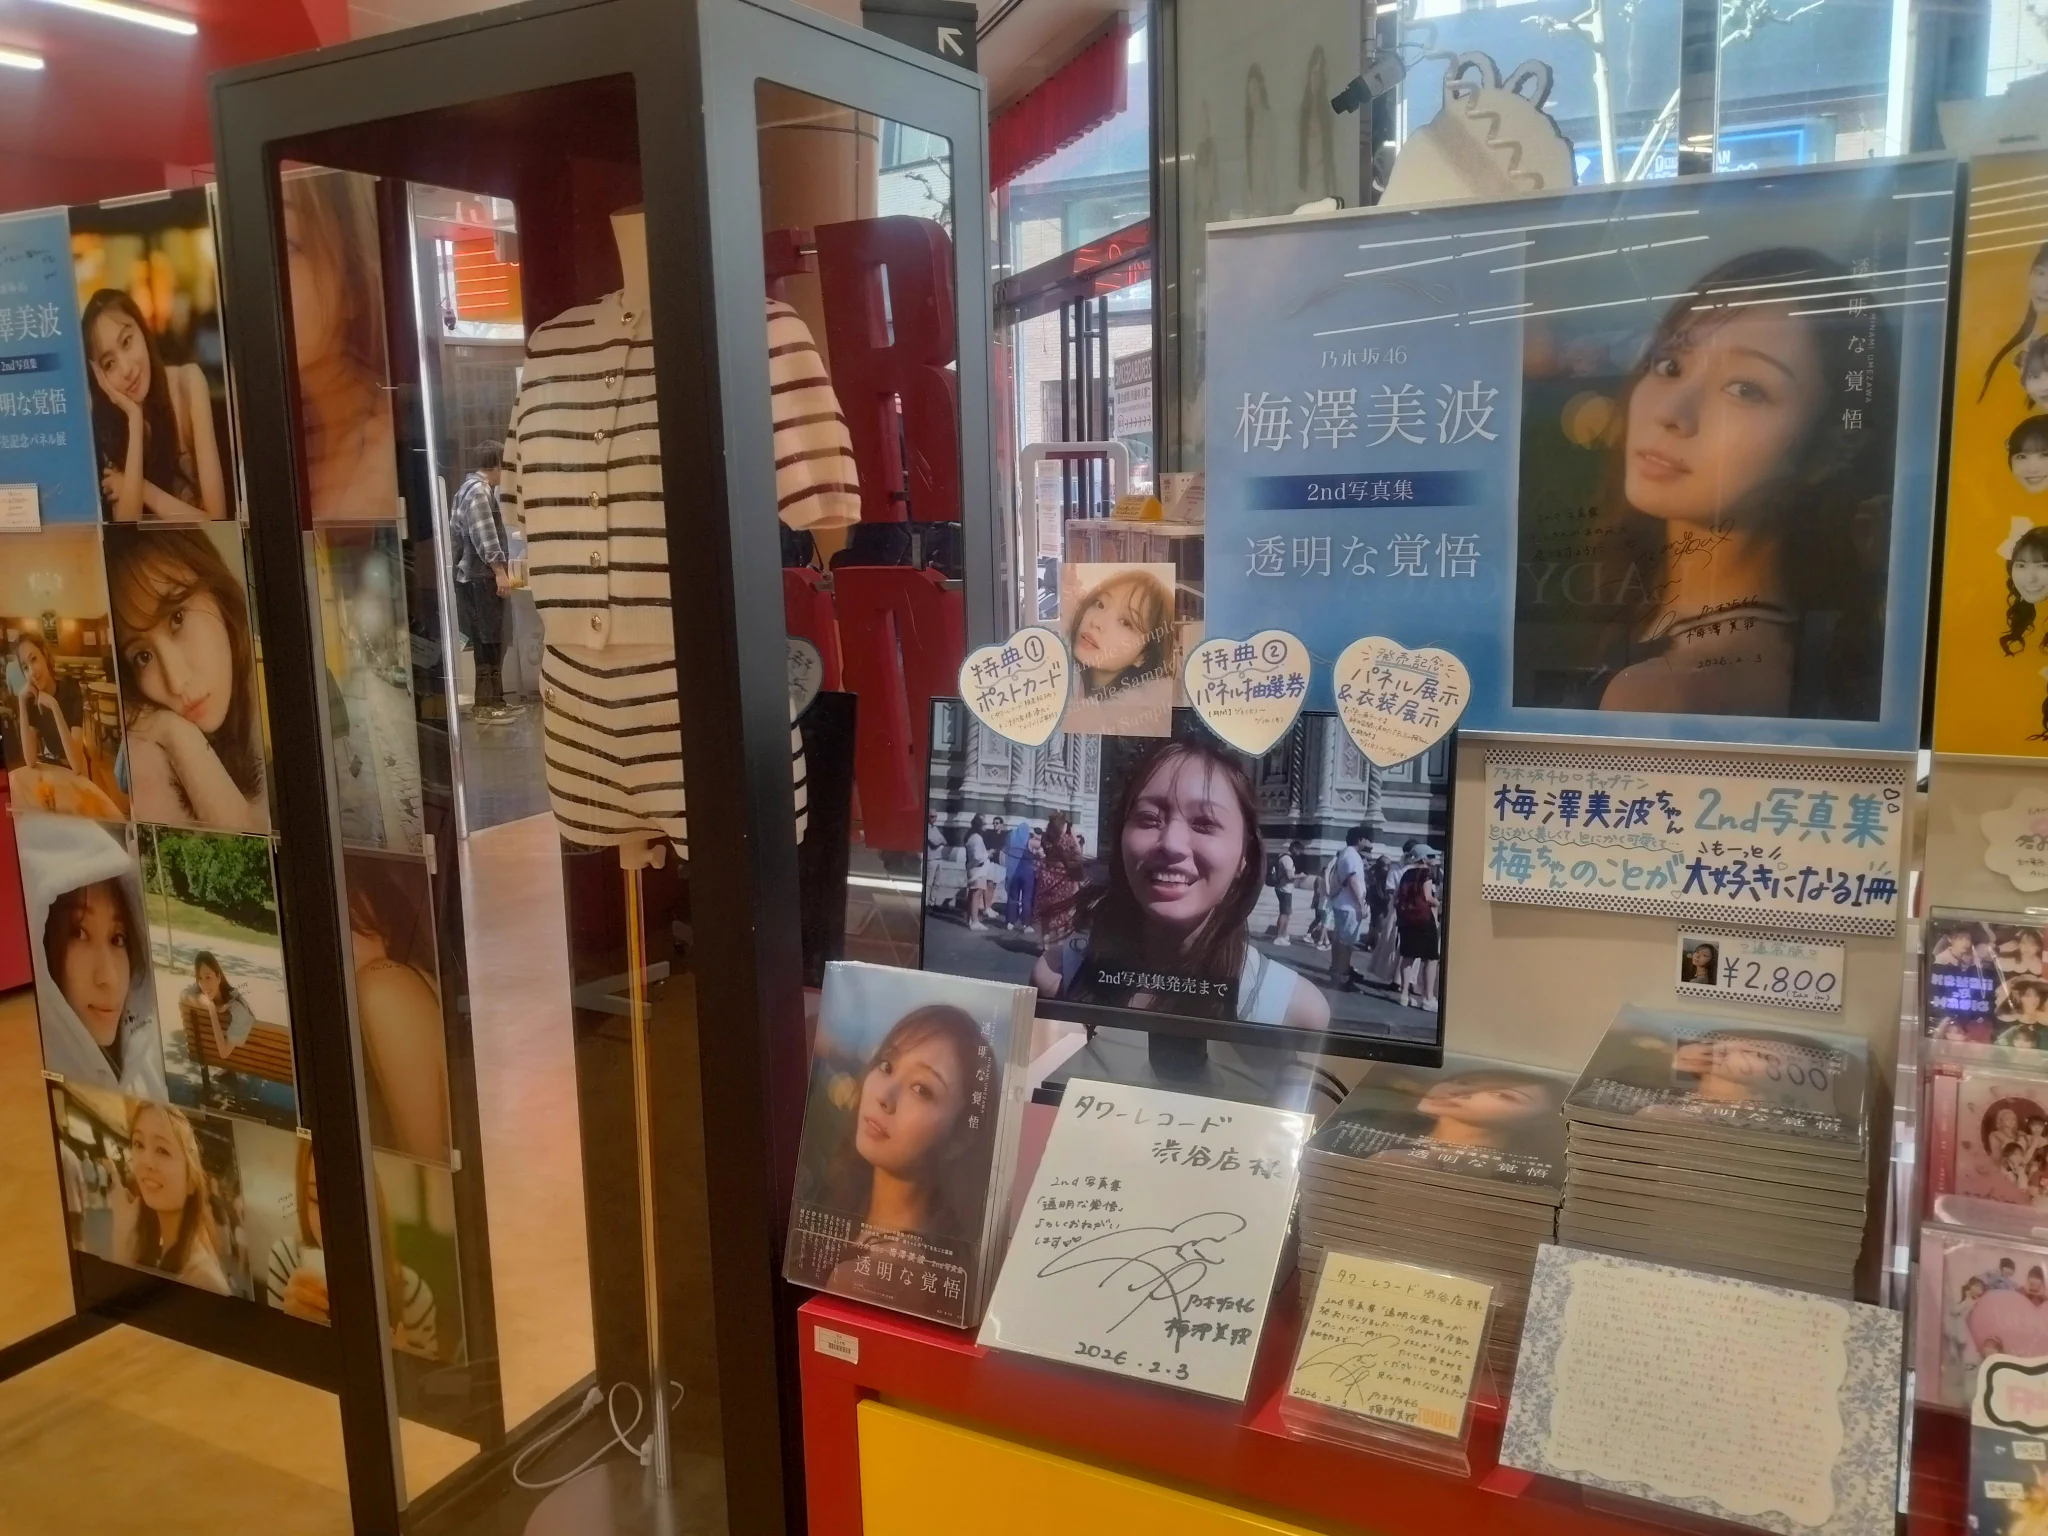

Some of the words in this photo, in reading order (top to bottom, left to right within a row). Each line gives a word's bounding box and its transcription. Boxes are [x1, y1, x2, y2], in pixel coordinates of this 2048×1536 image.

[1320, 346, 1408, 369] 乃木坂46
[1233, 380, 1500, 453] 梅澤美波
[1306, 479, 1414, 502] 2nd写真集
[1244, 532, 1482, 579] 透明な覚悟
[976, 661, 1062, 713] ポストカード
[1196, 671, 1306, 706] パネル抽選券
[1351, 667, 1460, 706] パネル展示
[1694, 788, 1889, 848] 2nd写真集
[1098, 970, 1229, 997] 2nd写真集発売まで
[967, 1020, 992, 1130] 透明な覚悟
[1074, 1094, 1233, 1134] タワーレコード
[854, 1254, 961, 1300] 透明な覚悟
